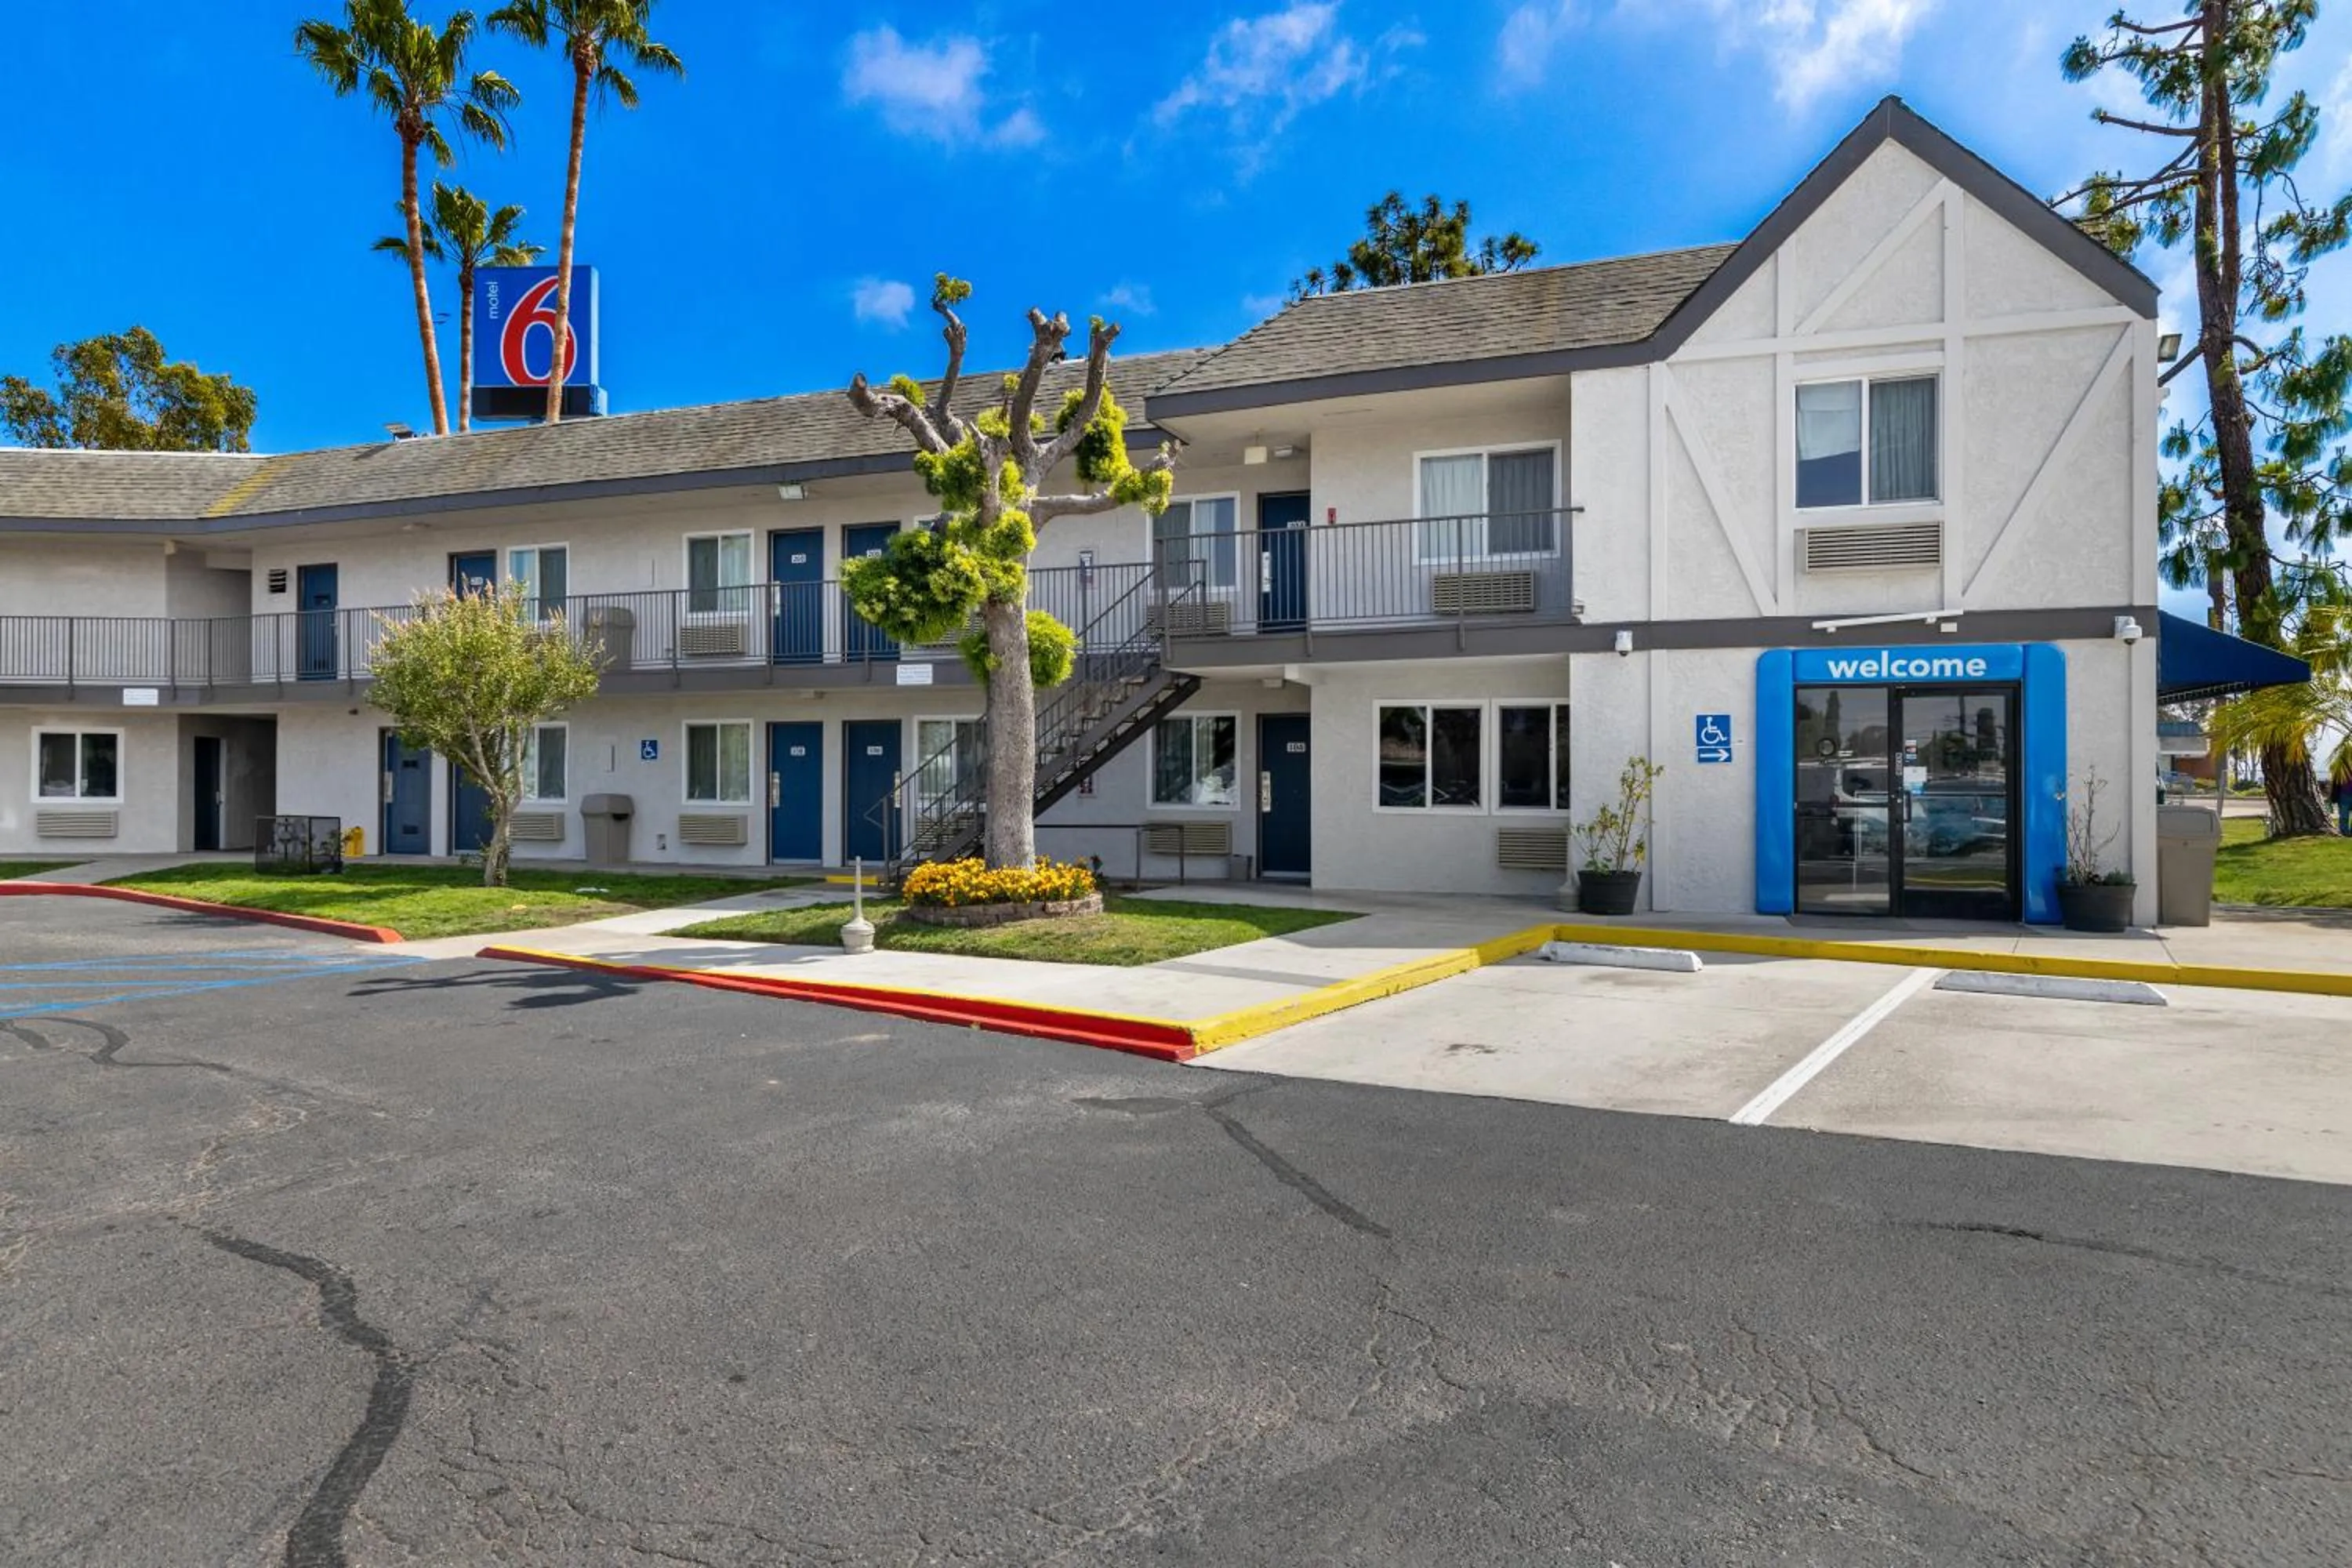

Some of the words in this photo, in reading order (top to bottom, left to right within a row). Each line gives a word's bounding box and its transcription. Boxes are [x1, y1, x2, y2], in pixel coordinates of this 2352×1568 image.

[485, 281, 499, 319] motel
[500, 275, 578, 387] 6
[1828, 650, 1987, 678] welcome
